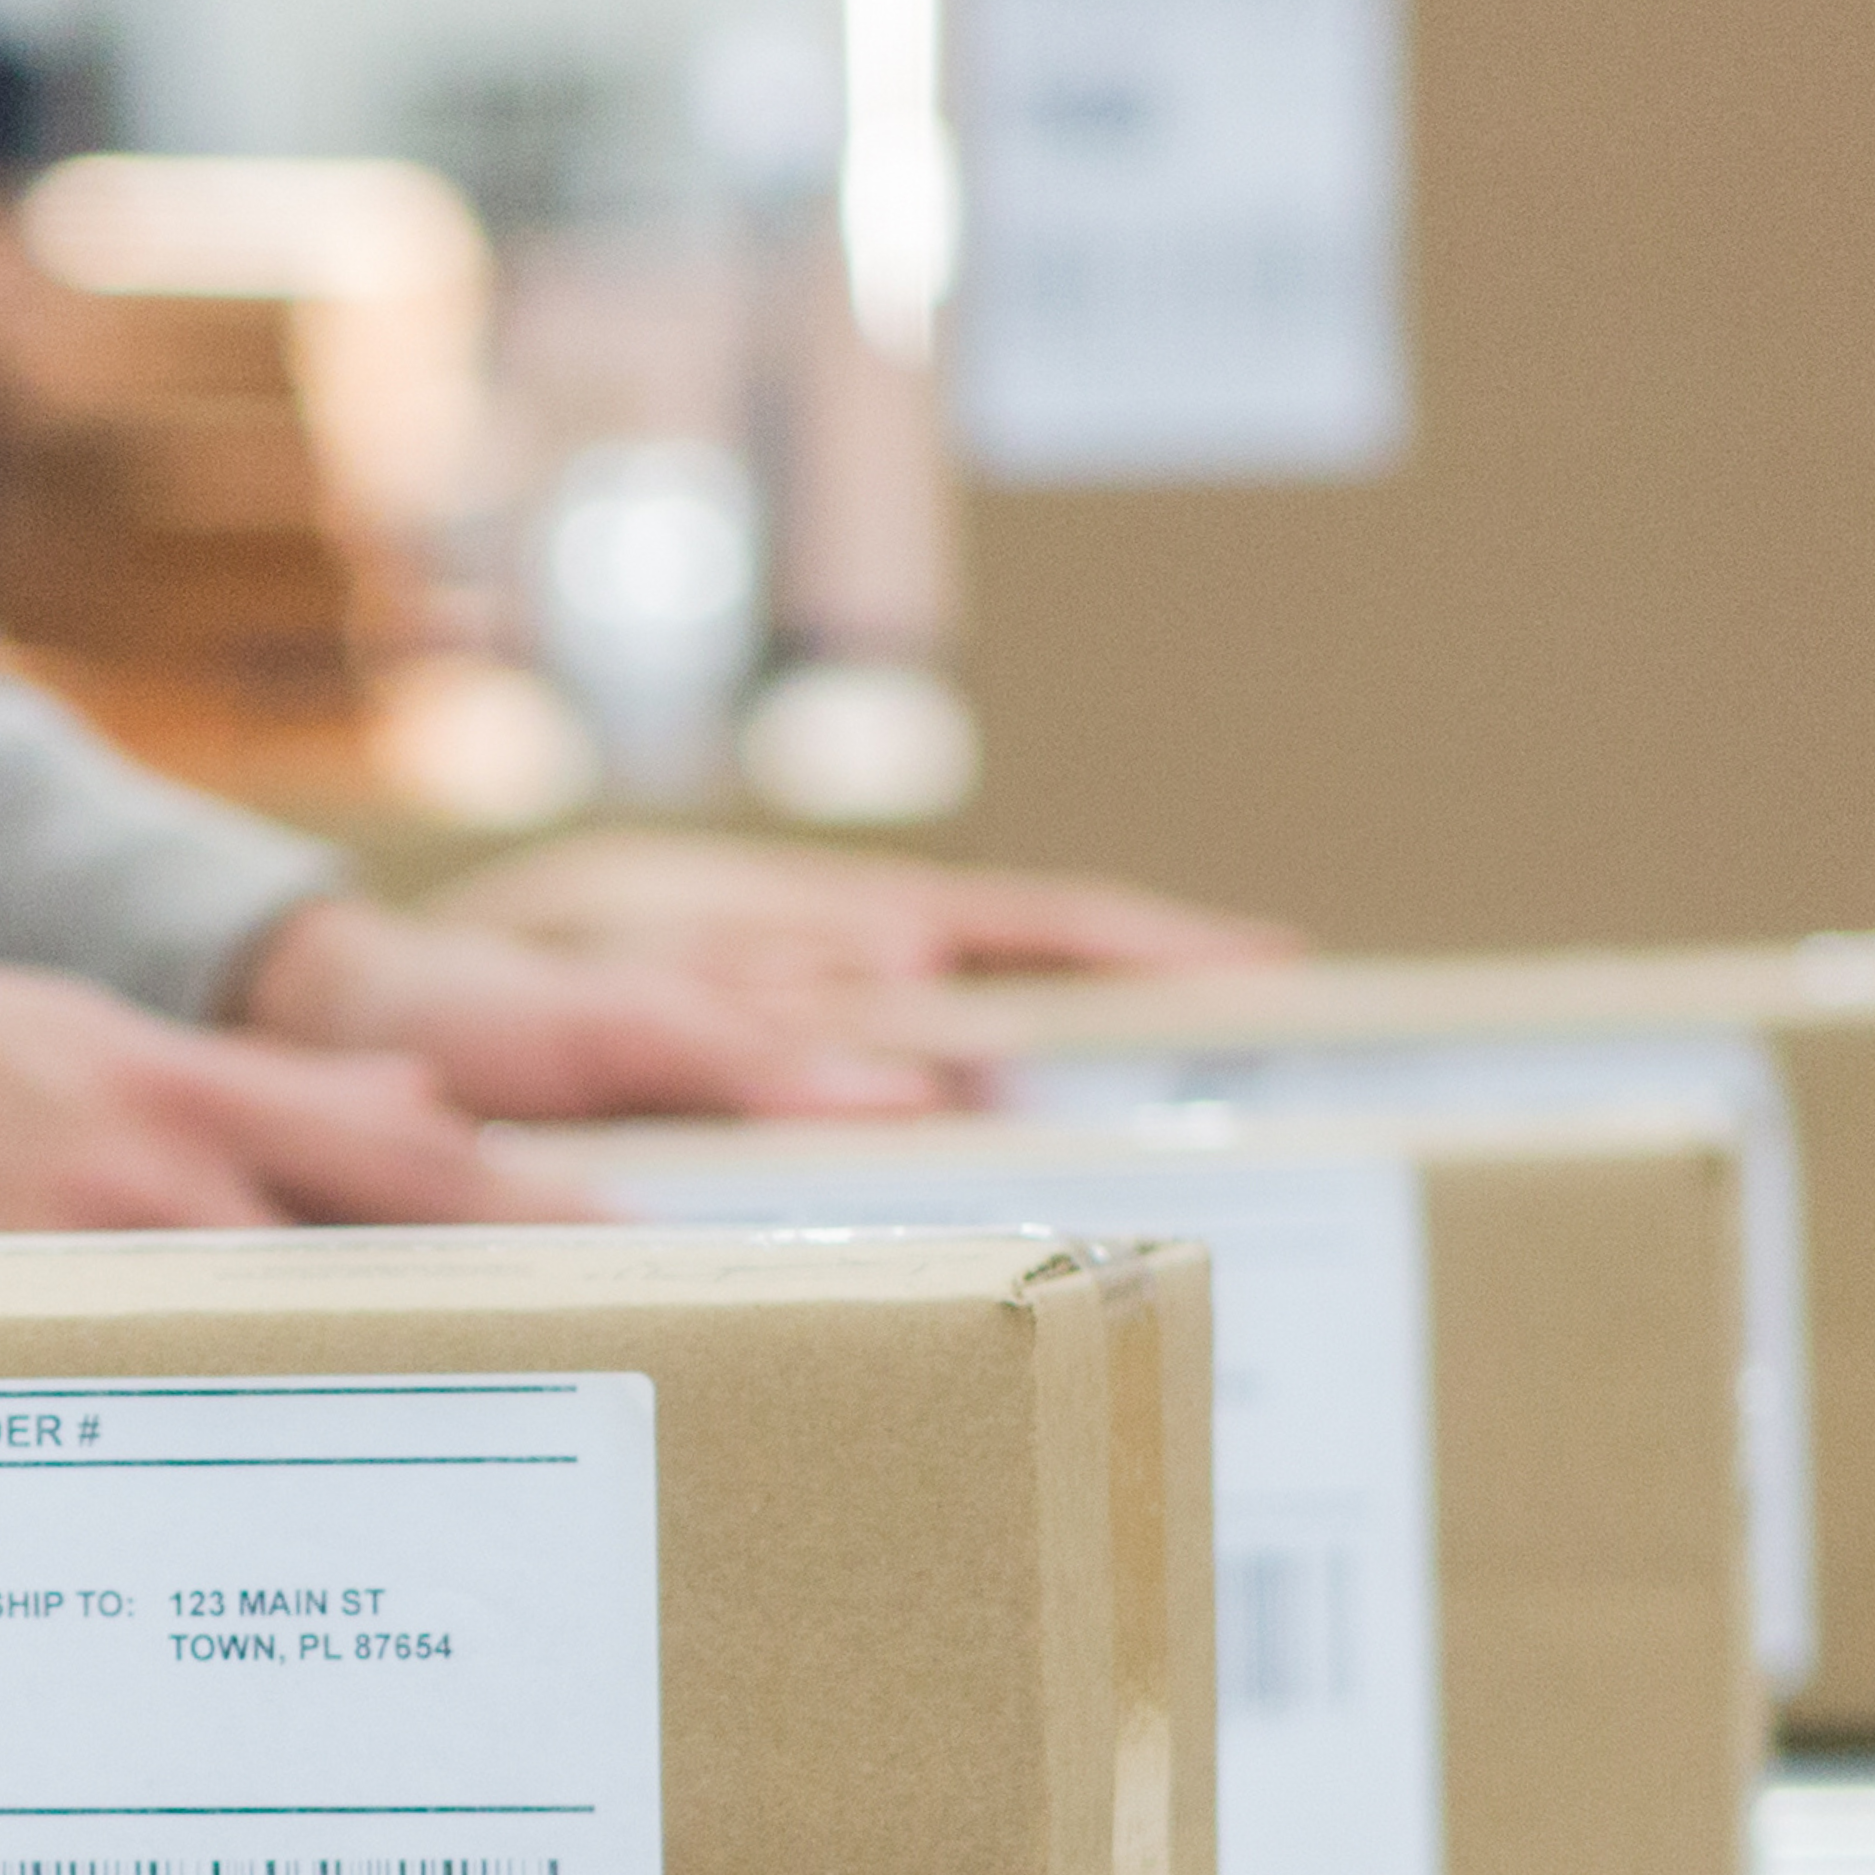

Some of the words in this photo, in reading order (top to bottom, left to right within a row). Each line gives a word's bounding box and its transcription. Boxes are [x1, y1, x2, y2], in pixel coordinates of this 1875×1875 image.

[78, 1414, 102, 1446] #
[76, 1589, 134, 1618] TO:
[169, 1589, 227, 1618] 123
[238, 1588, 329, 1617] MAIN
[341, 1587, 386, 1617] ST
[168, 1633, 286, 1665] TOWN,
[298, 1632, 343, 1661] PL
[353, 1632, 454, 1661] 87654
